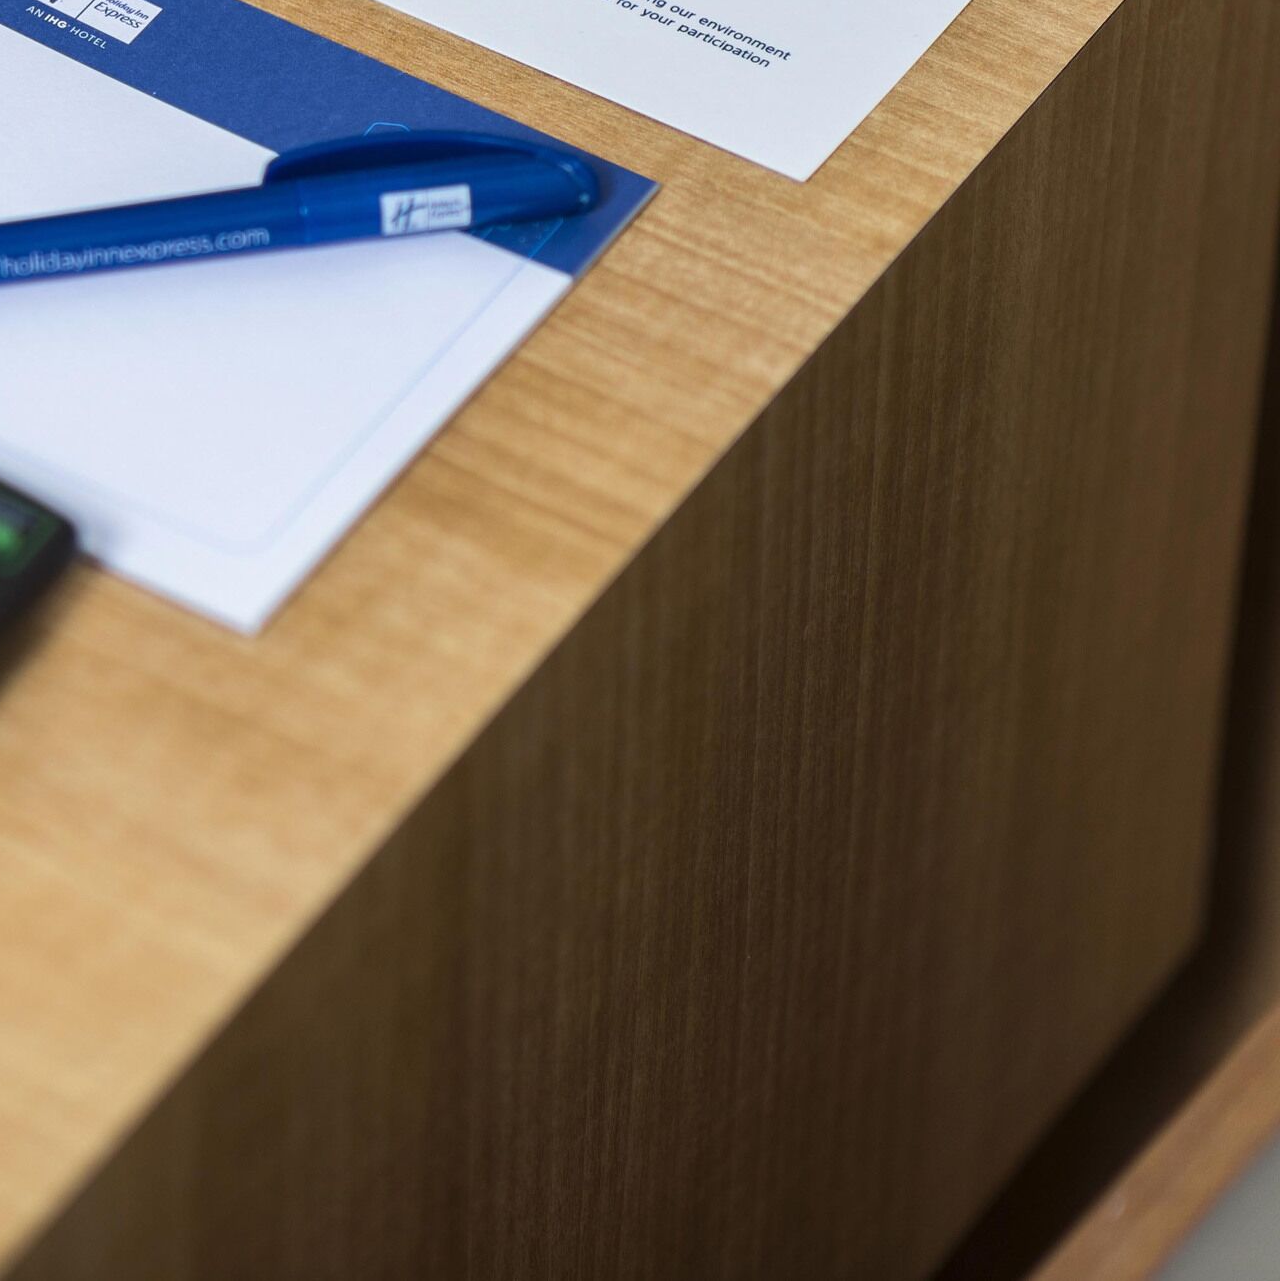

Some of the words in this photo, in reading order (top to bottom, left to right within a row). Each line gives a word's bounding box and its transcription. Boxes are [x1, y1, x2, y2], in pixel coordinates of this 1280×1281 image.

[25, 5, 44, 19] AN
[69, 26, 108, 50] HOTEL
[93, 1, 143, 30] Express
[134, 9, 149, 21] Inn
[669, 5, 697, 19] our
[698, 17, 791, 61] environment
[639, 8, 675, 26] your
[676, 24, 770, 68] participation
